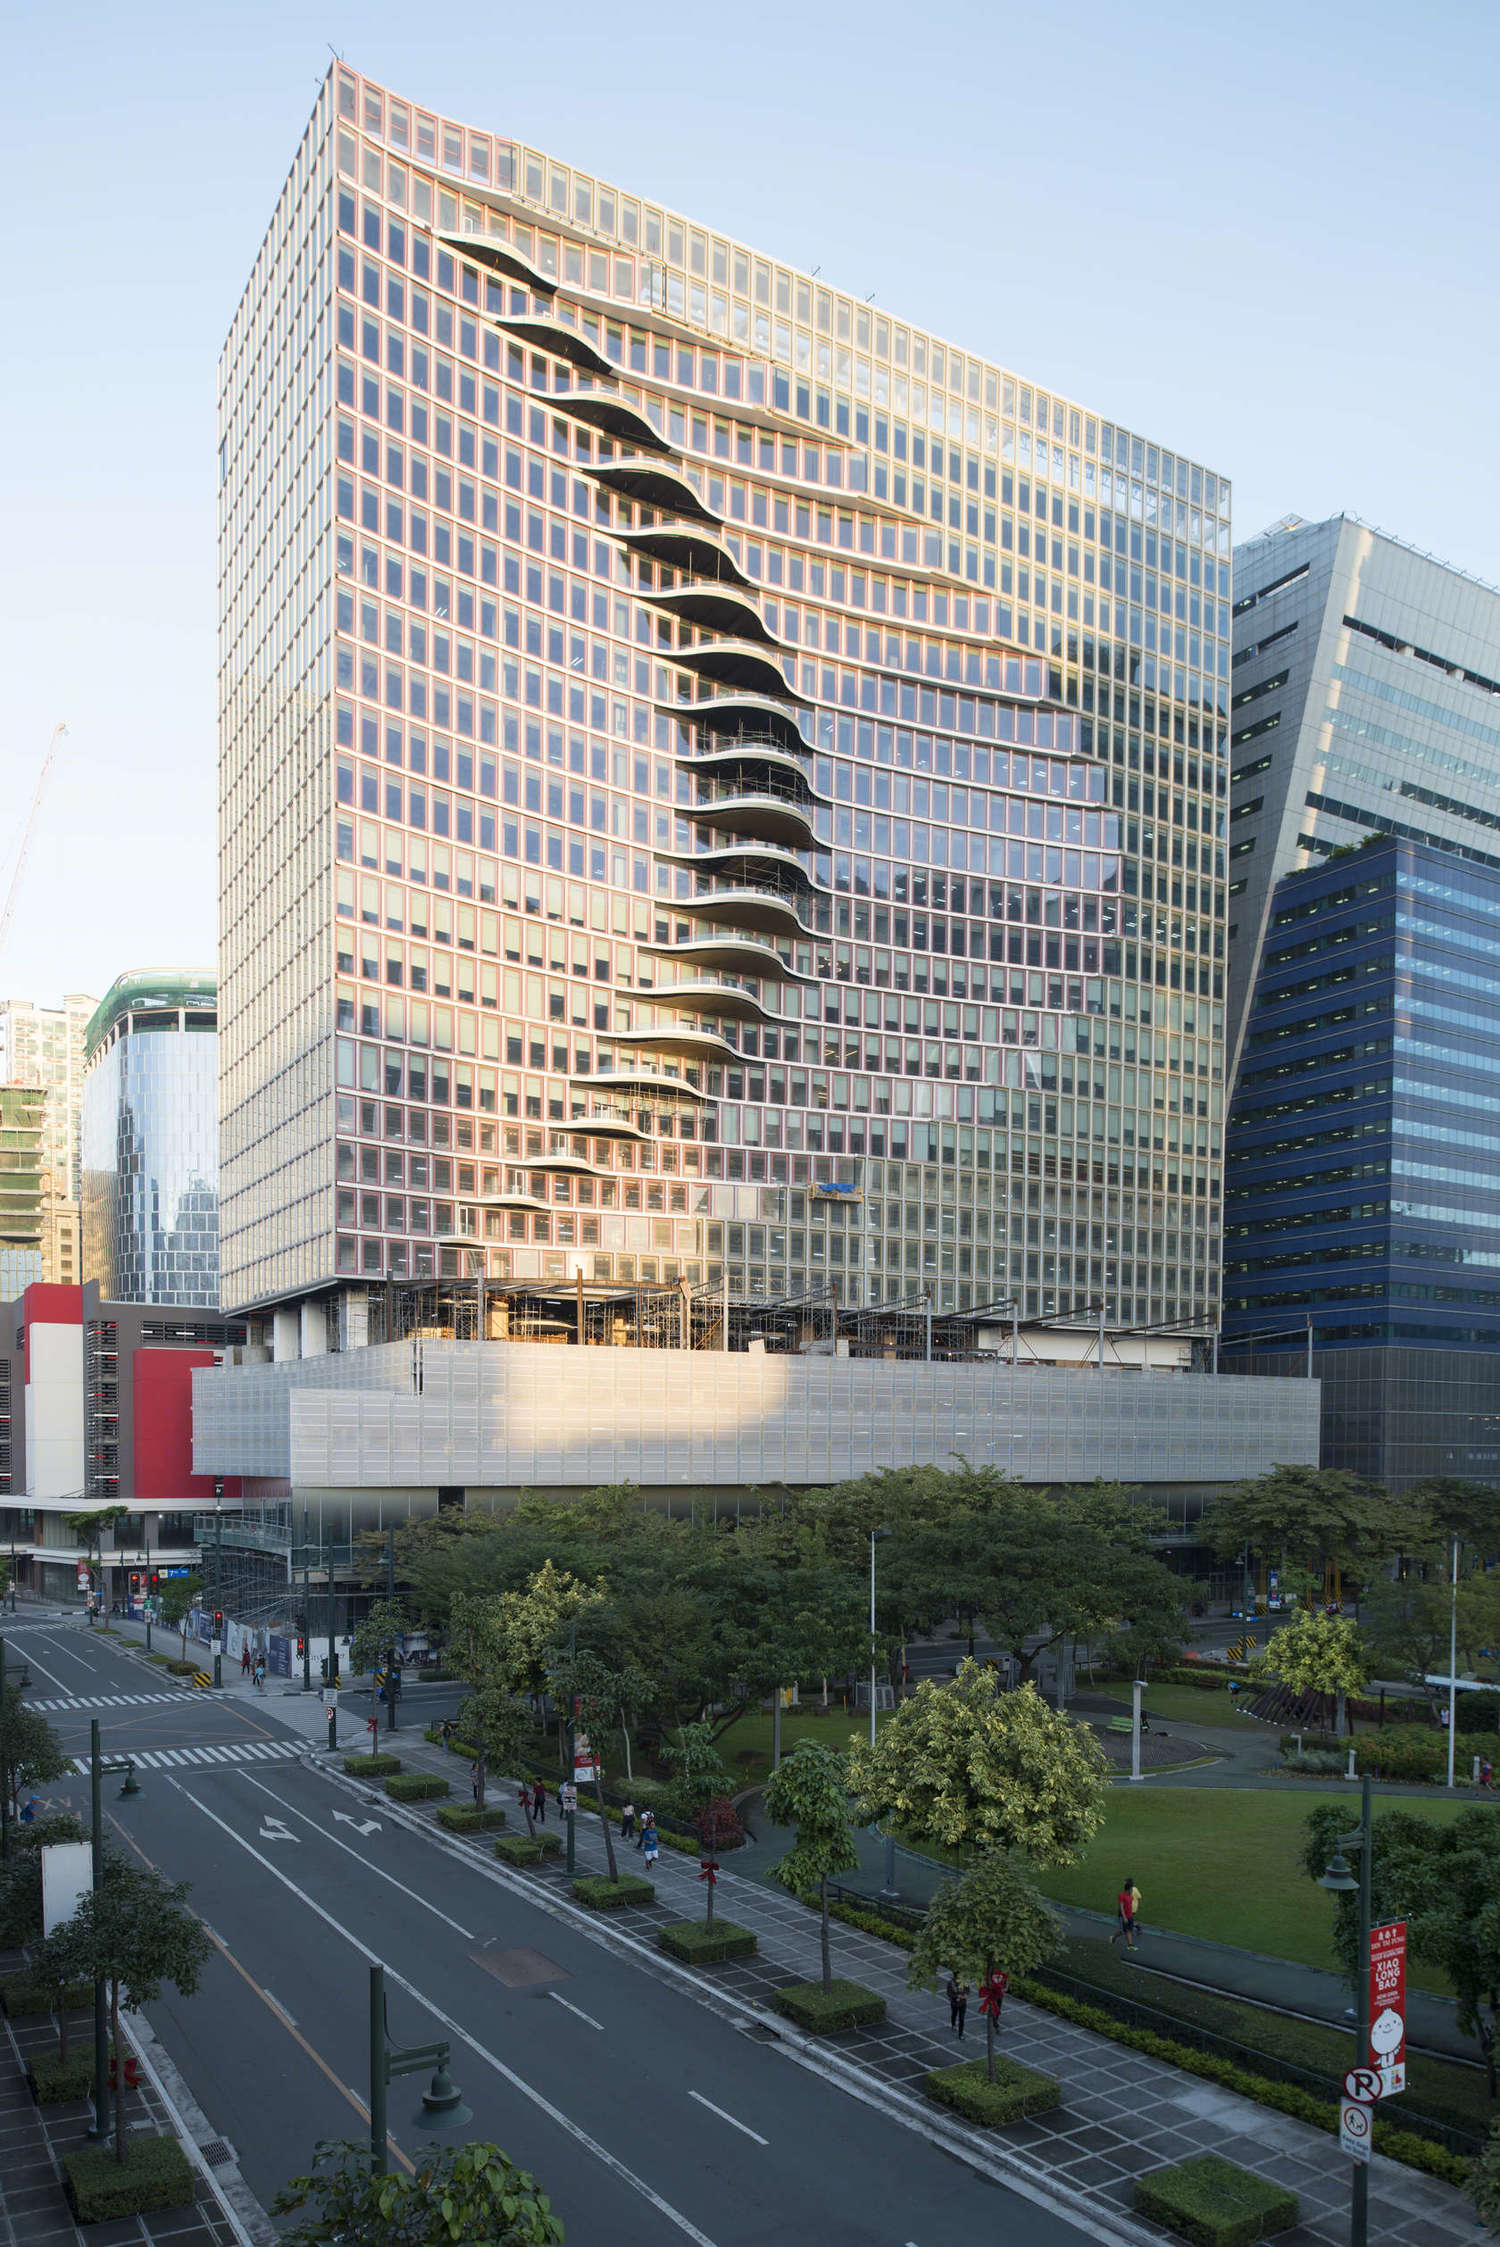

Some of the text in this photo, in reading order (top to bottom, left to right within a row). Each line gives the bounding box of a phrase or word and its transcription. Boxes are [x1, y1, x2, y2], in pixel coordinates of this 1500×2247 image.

[1377, 1957, 1399, 1972] XIAO
[1376, 1967, 1400, 1982] LONG
[1378, 1977, 1397, 1991] BAO
